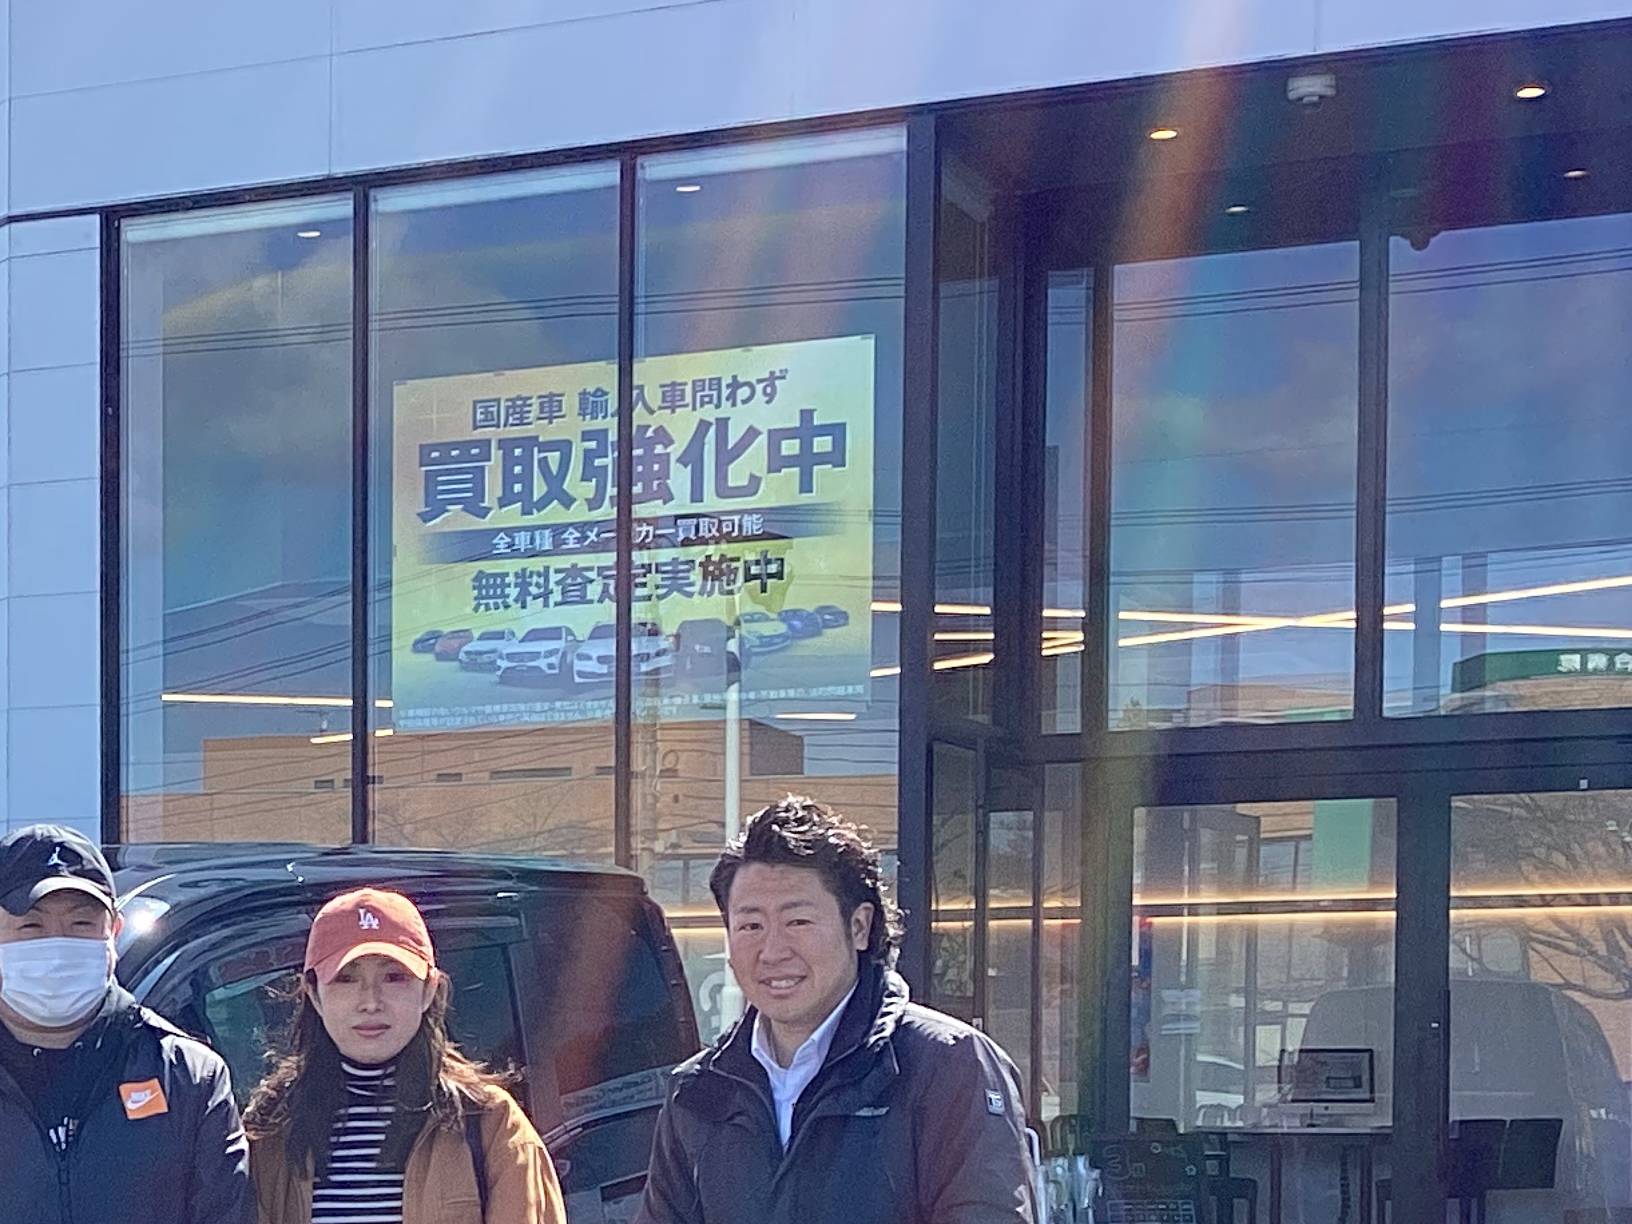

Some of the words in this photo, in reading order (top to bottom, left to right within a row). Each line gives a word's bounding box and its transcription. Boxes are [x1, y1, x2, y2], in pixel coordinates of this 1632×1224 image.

[471, 391, 567, 431] 国産車
[416, 408, 848, 525] 買取強化中
[491, 528, 554, 554] 全車種
[470, 549, 786, 614] 無料査定実施中
[357, 907, 380, 930] LA
